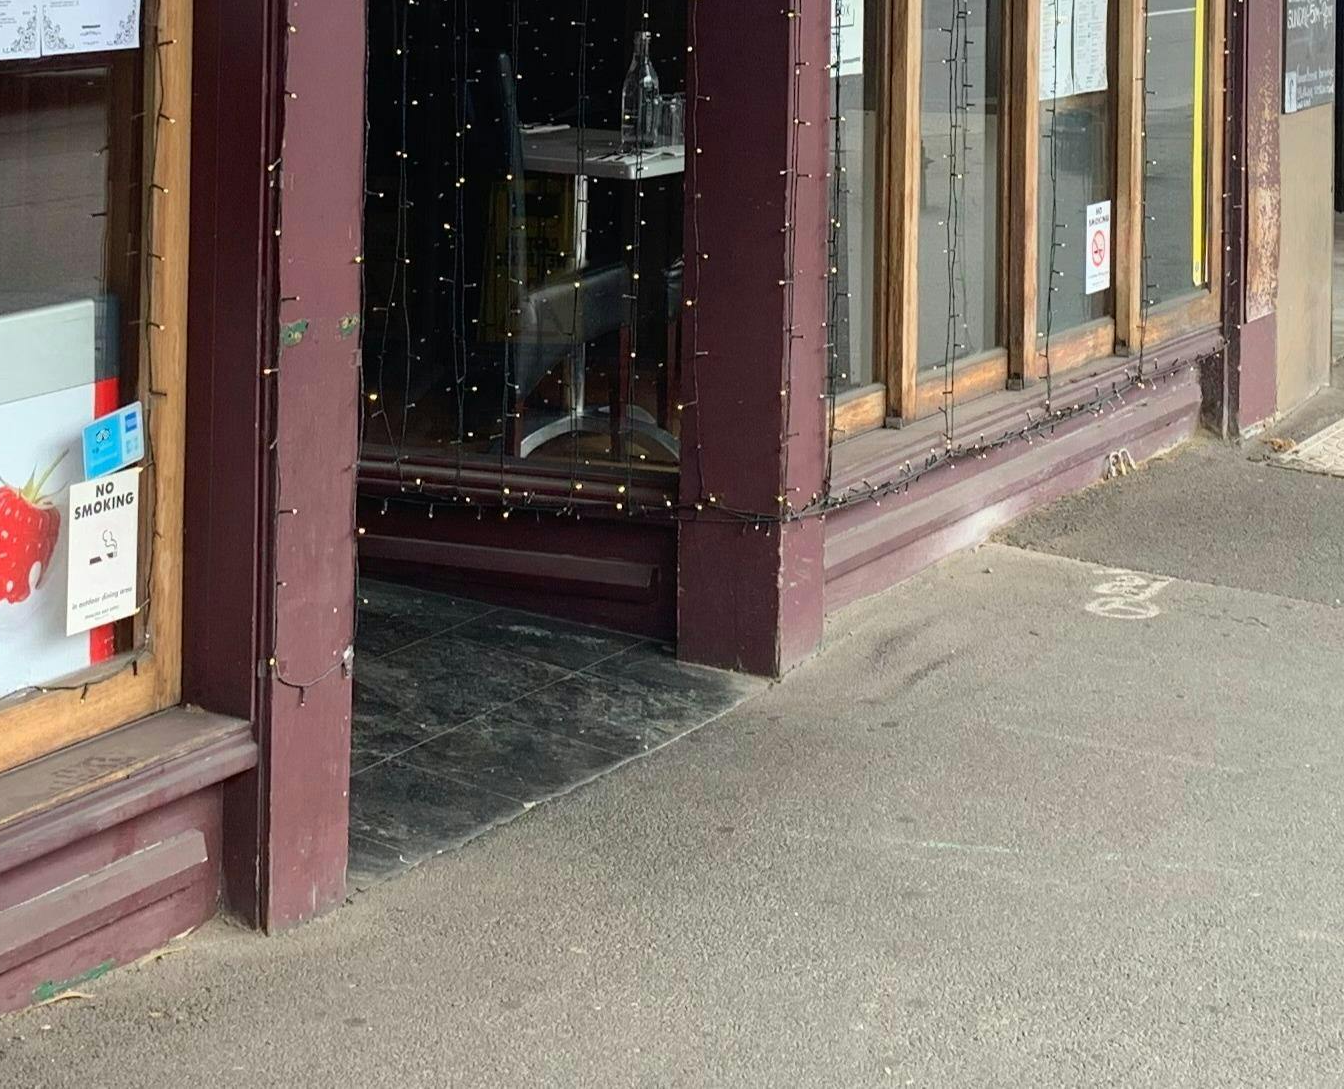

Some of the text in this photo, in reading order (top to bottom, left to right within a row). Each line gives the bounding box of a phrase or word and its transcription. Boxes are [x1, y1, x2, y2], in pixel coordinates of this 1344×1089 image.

[95, 481, 115, 499] NO
[73, 493, 135, 521] SMOKING
[78, 597, 100, 608] outdoor
